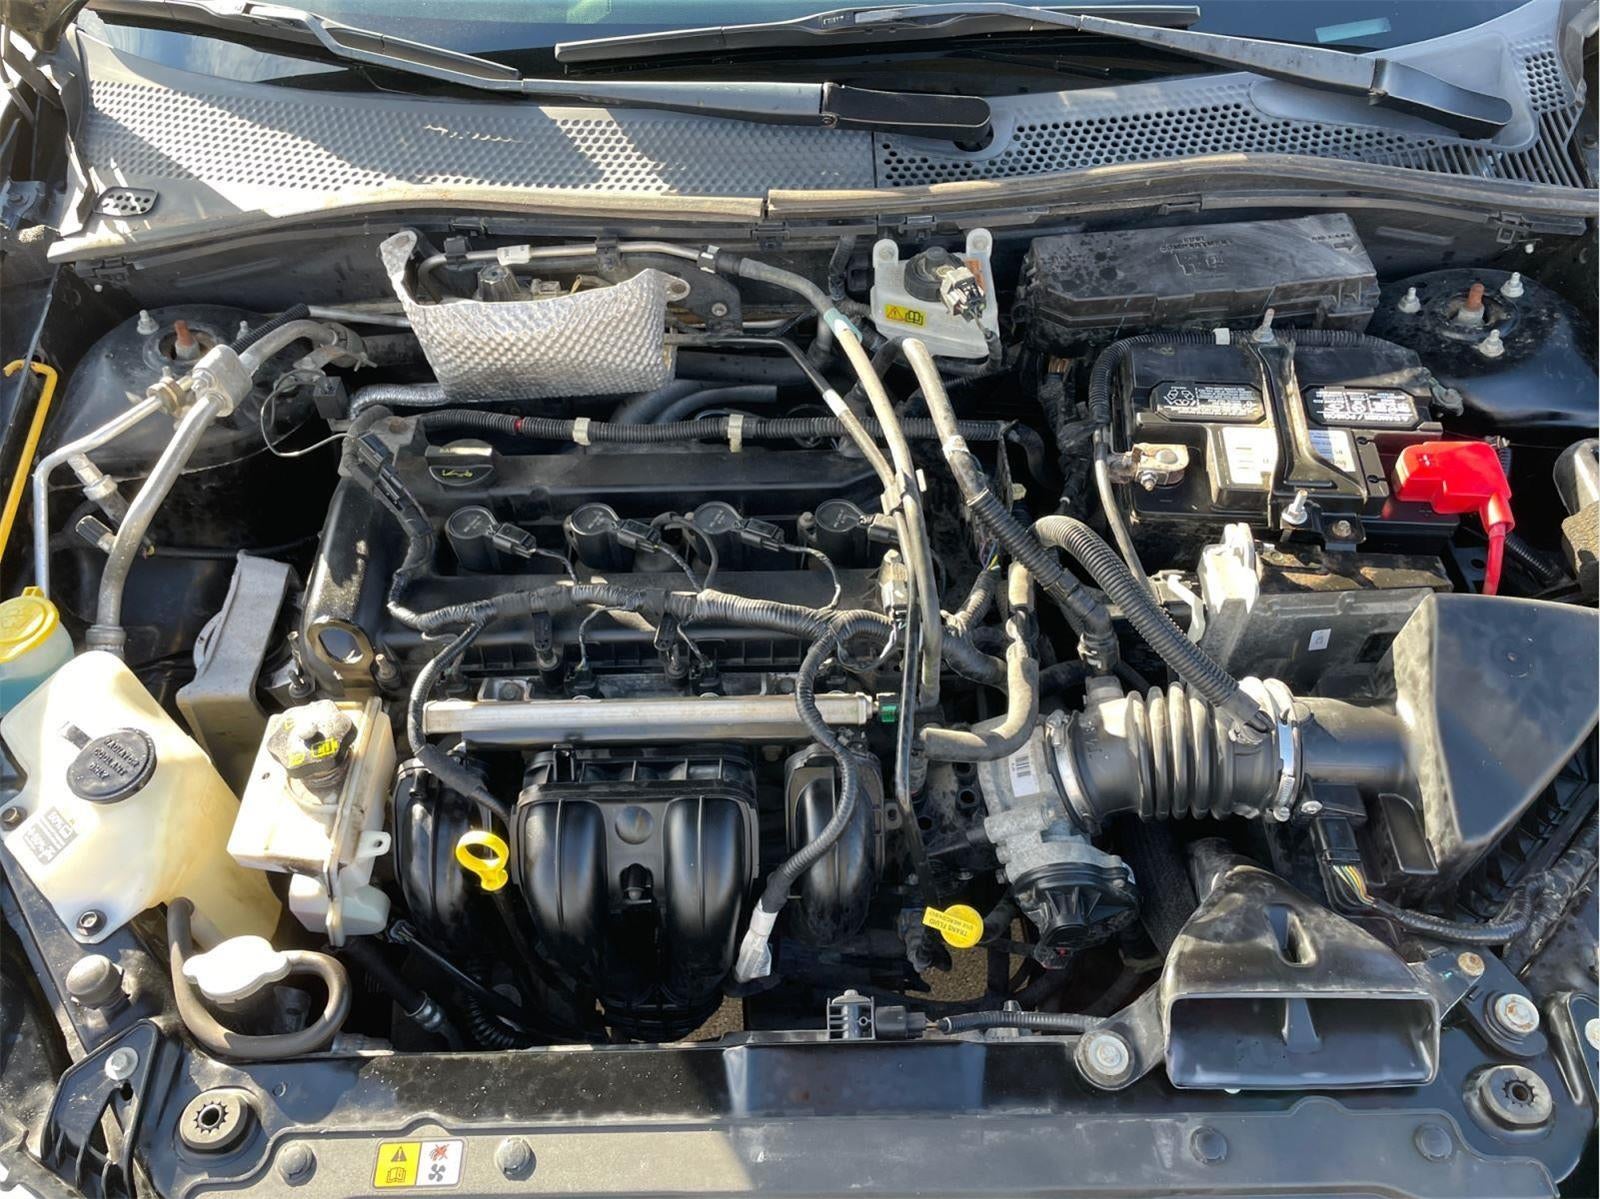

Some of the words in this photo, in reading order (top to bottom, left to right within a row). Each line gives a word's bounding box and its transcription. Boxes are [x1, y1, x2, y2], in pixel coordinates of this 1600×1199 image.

[1323, 412, 1356, 421] POISON
[103, 736, 140, 768] RADIATOR
[94, 747, 128, 776] COOLANT
[89, 761, 110, 780] ONLY
[929, 918, 947, 930] FLUID
[948, 924, 969, 937] TRANS
